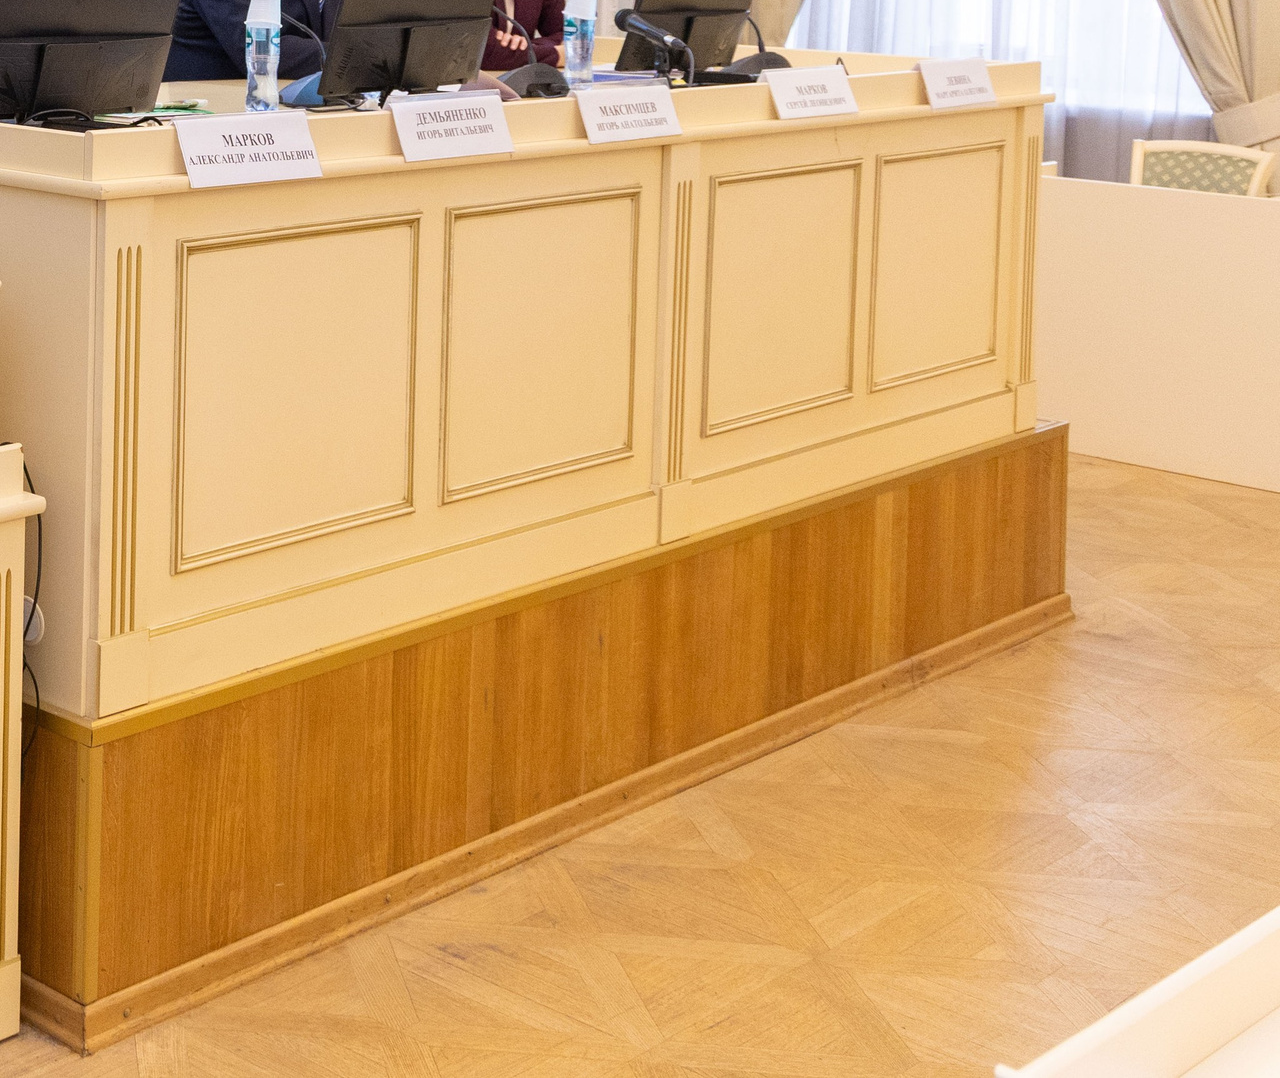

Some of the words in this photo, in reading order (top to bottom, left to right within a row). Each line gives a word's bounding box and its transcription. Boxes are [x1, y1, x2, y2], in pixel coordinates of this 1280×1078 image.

[796, 84, 828, 96] МАРКОВ
[416, 107, 487, 126] ДЕМЬЯНЕНКО
[599, 102, 657, 117] МАКСИМЦЕВ
[416, 130, 443, 140] ИГОРЬ
[444, 124, 495, 138] ВИТАЛЬЕВИЧ
[596, 122, 620, 132] ИГОРЬ
[620, 117, 669, 130] АНАТОЛЬЕВИЧ
[222, 133, 275, 148] МАРКОВ
[189, 153, 246, 166] АЛЕКСАНДР
[248, 150, 315, 163] АНАТОЛЬЕВИЧ
